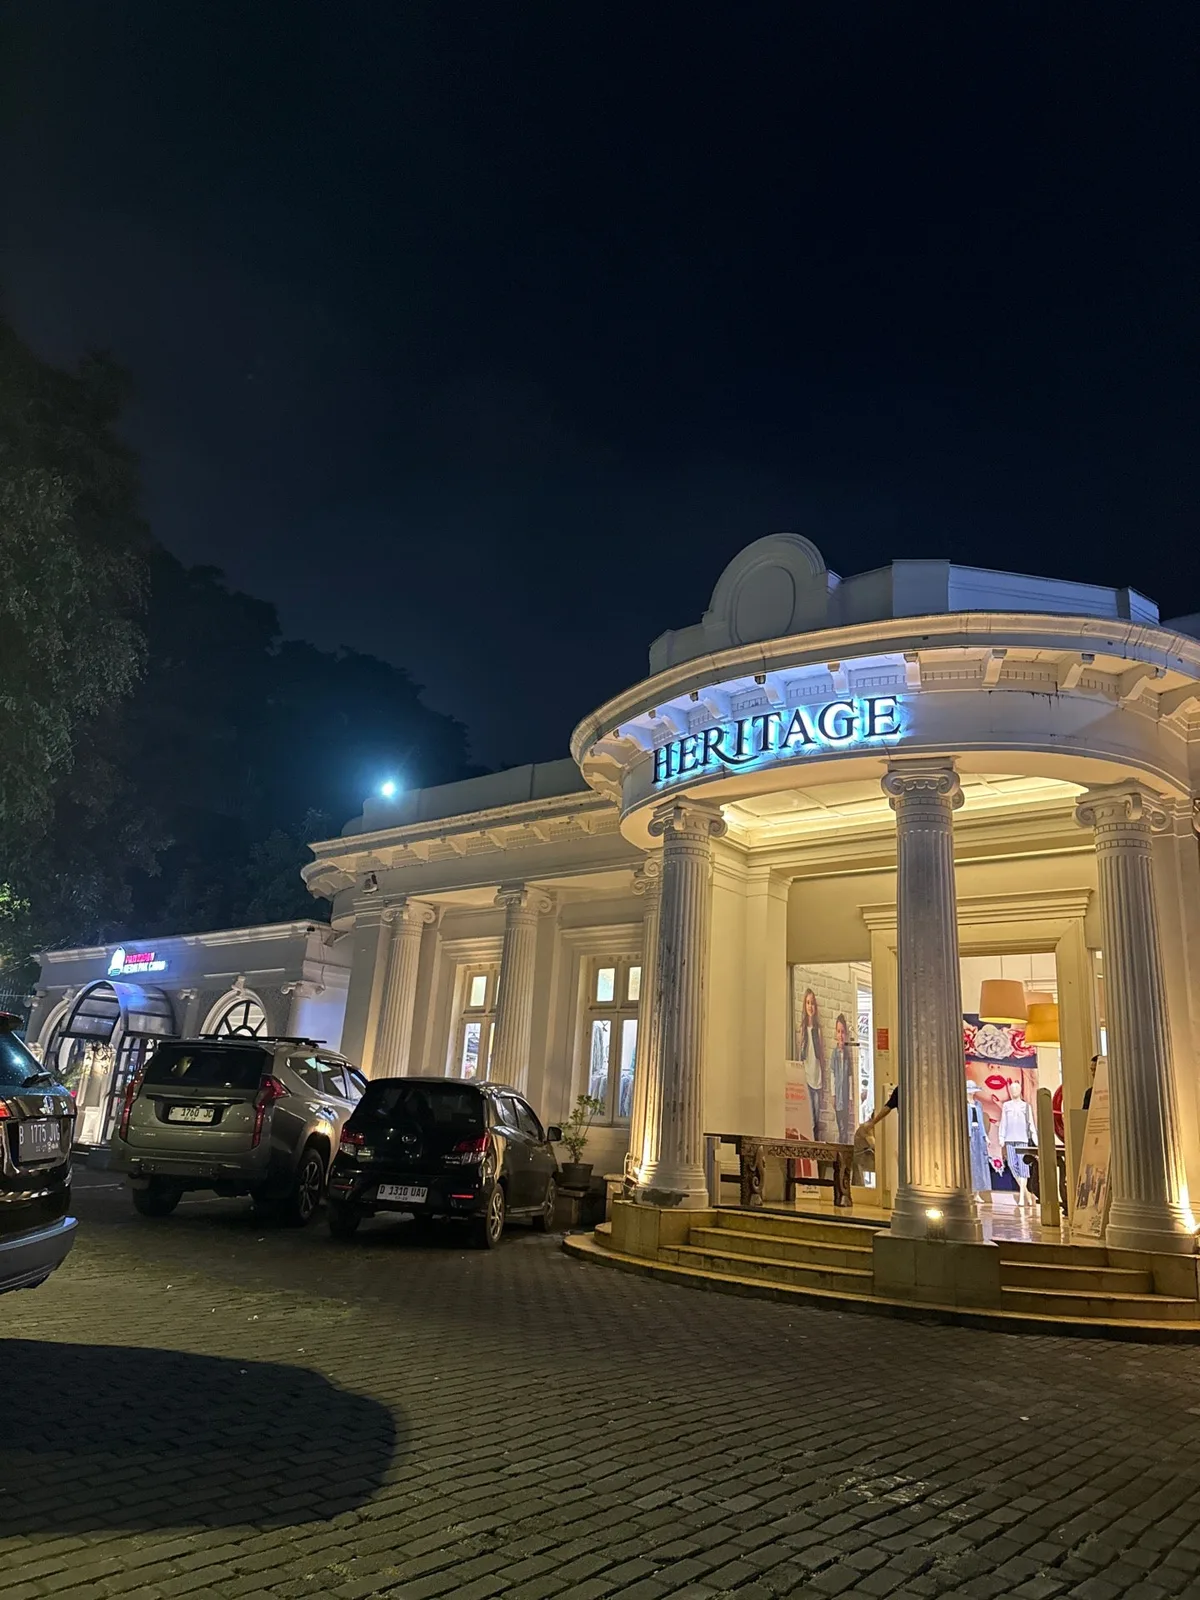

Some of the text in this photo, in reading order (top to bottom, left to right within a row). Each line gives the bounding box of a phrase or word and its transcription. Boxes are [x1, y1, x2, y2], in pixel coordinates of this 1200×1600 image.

[651, 695, 901, 784] HERITAGE
[19, 1125, 24, 1145] B
[31, 1124, 47, 1143] 1775
[380, 1185, 386, 1194] D
[388, 1186, 409, 1196] 1310
